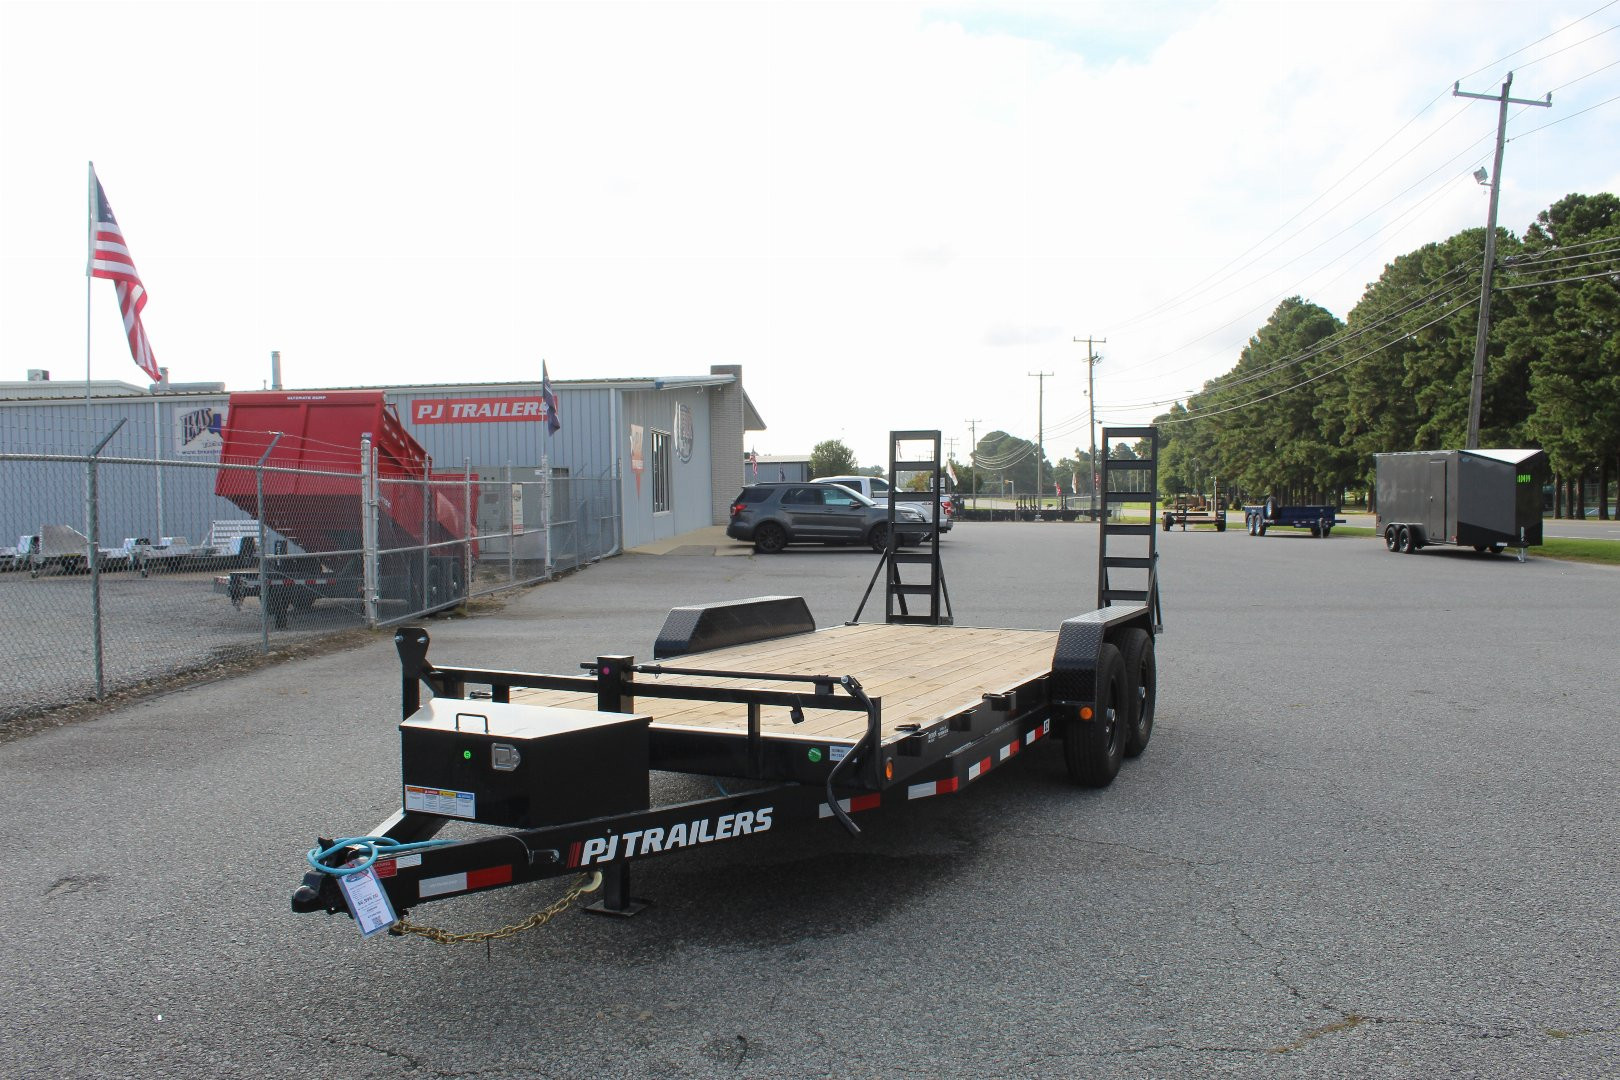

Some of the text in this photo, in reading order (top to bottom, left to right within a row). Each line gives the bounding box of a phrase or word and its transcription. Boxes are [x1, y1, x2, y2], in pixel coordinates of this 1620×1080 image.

[417, 401, 549, 419] PJ TRAILERS
[581, 807, 773, 866] PJ TRAILERS
